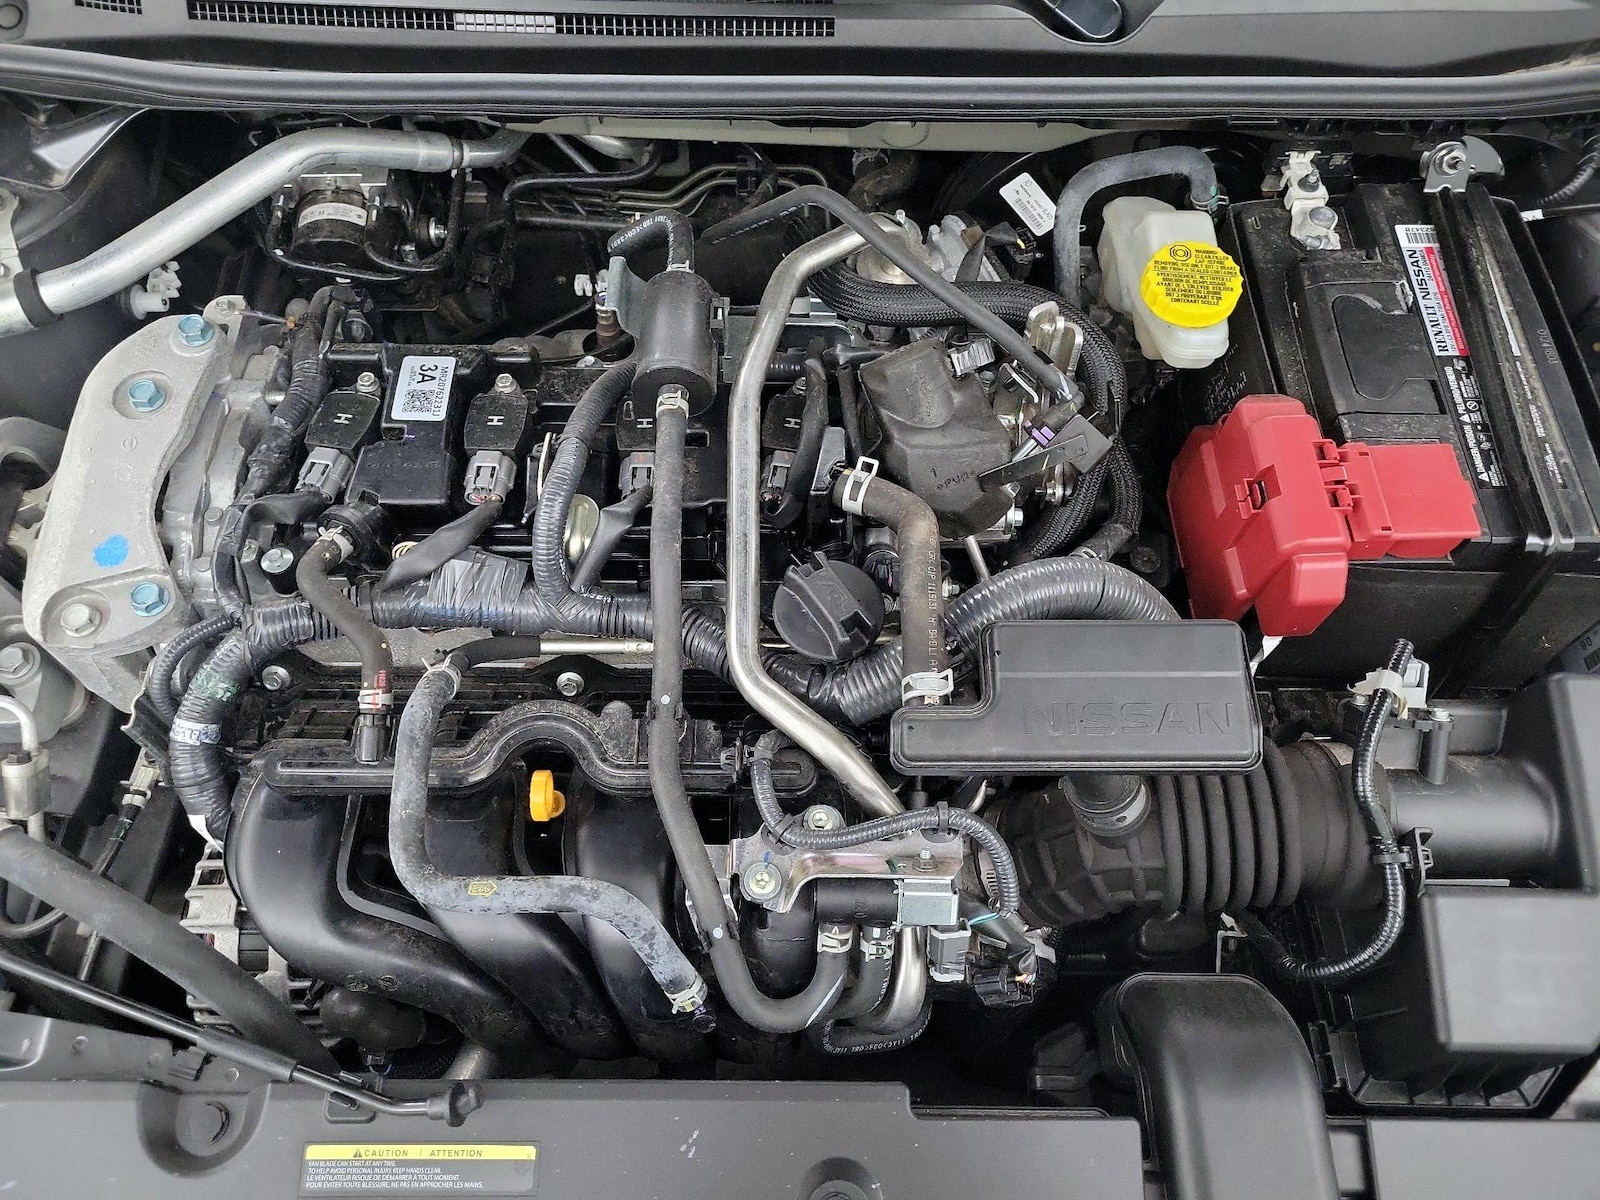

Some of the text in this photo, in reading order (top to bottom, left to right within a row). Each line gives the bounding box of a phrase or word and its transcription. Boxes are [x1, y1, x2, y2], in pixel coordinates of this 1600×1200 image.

[1406, 250, 1449, 352] RENAULT NISSAN
[416, 364, 438, 384] 3A
[1462, 424, 1486, 472] DANGER/POISON
[1022, 702, 1233, 736] NISSAN
[364, 1149, 408, 1157] CAUTION
[429, 1149, 483, 1157] ATTENTION
